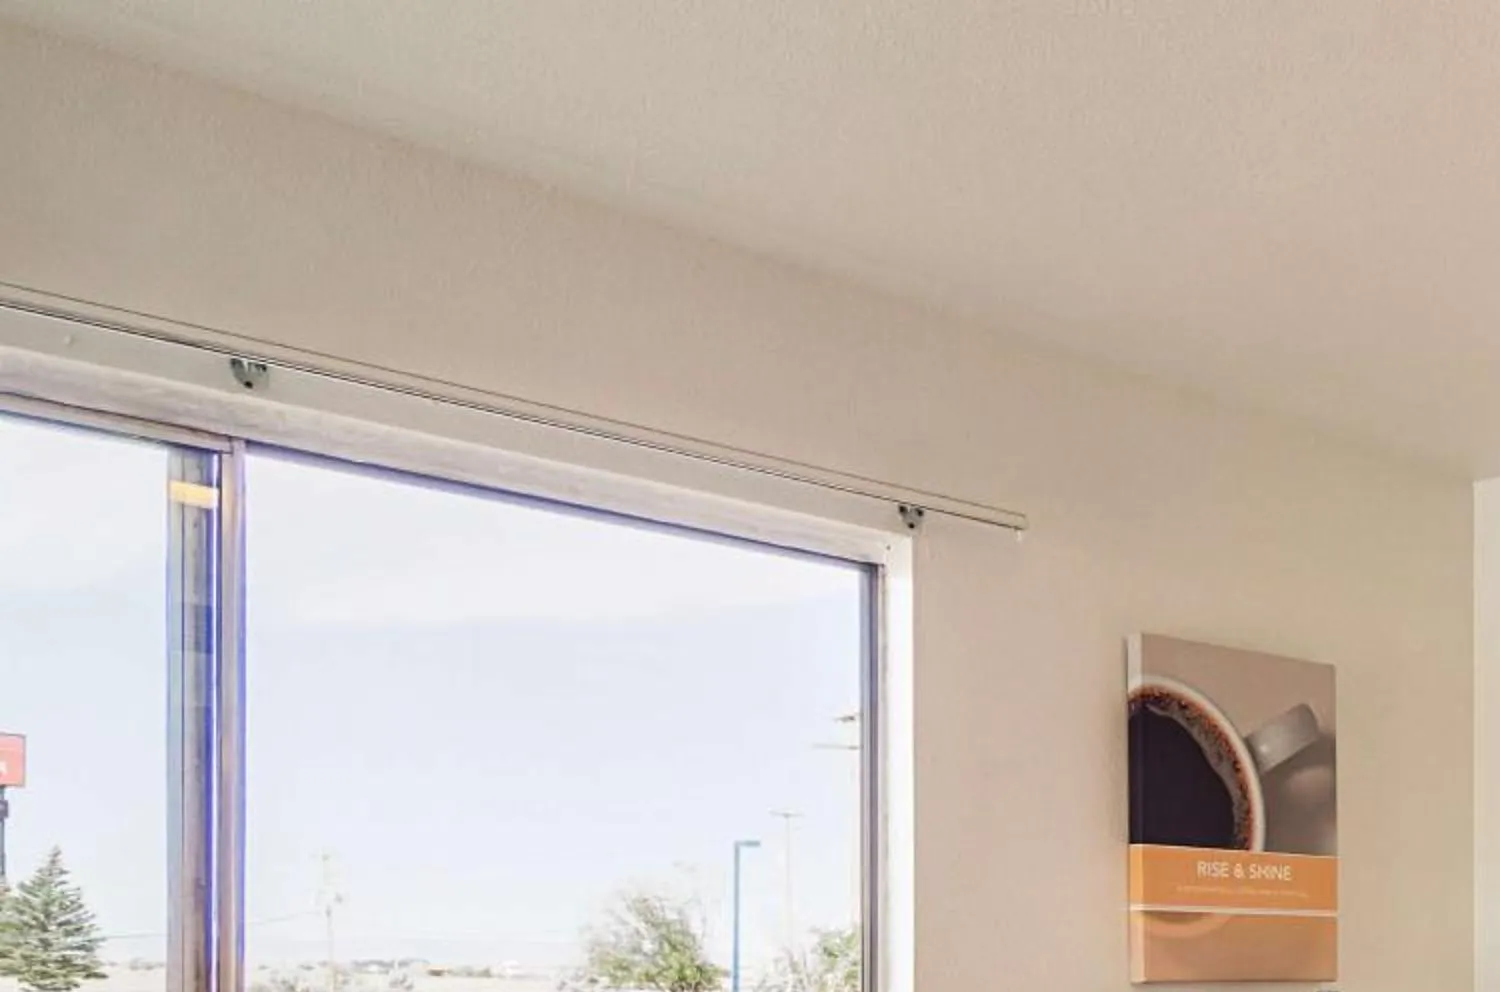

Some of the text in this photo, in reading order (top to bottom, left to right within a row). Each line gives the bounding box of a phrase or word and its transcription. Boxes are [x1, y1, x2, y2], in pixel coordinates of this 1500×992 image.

[1197, 860, 1293, 881] RISE & SHINE
